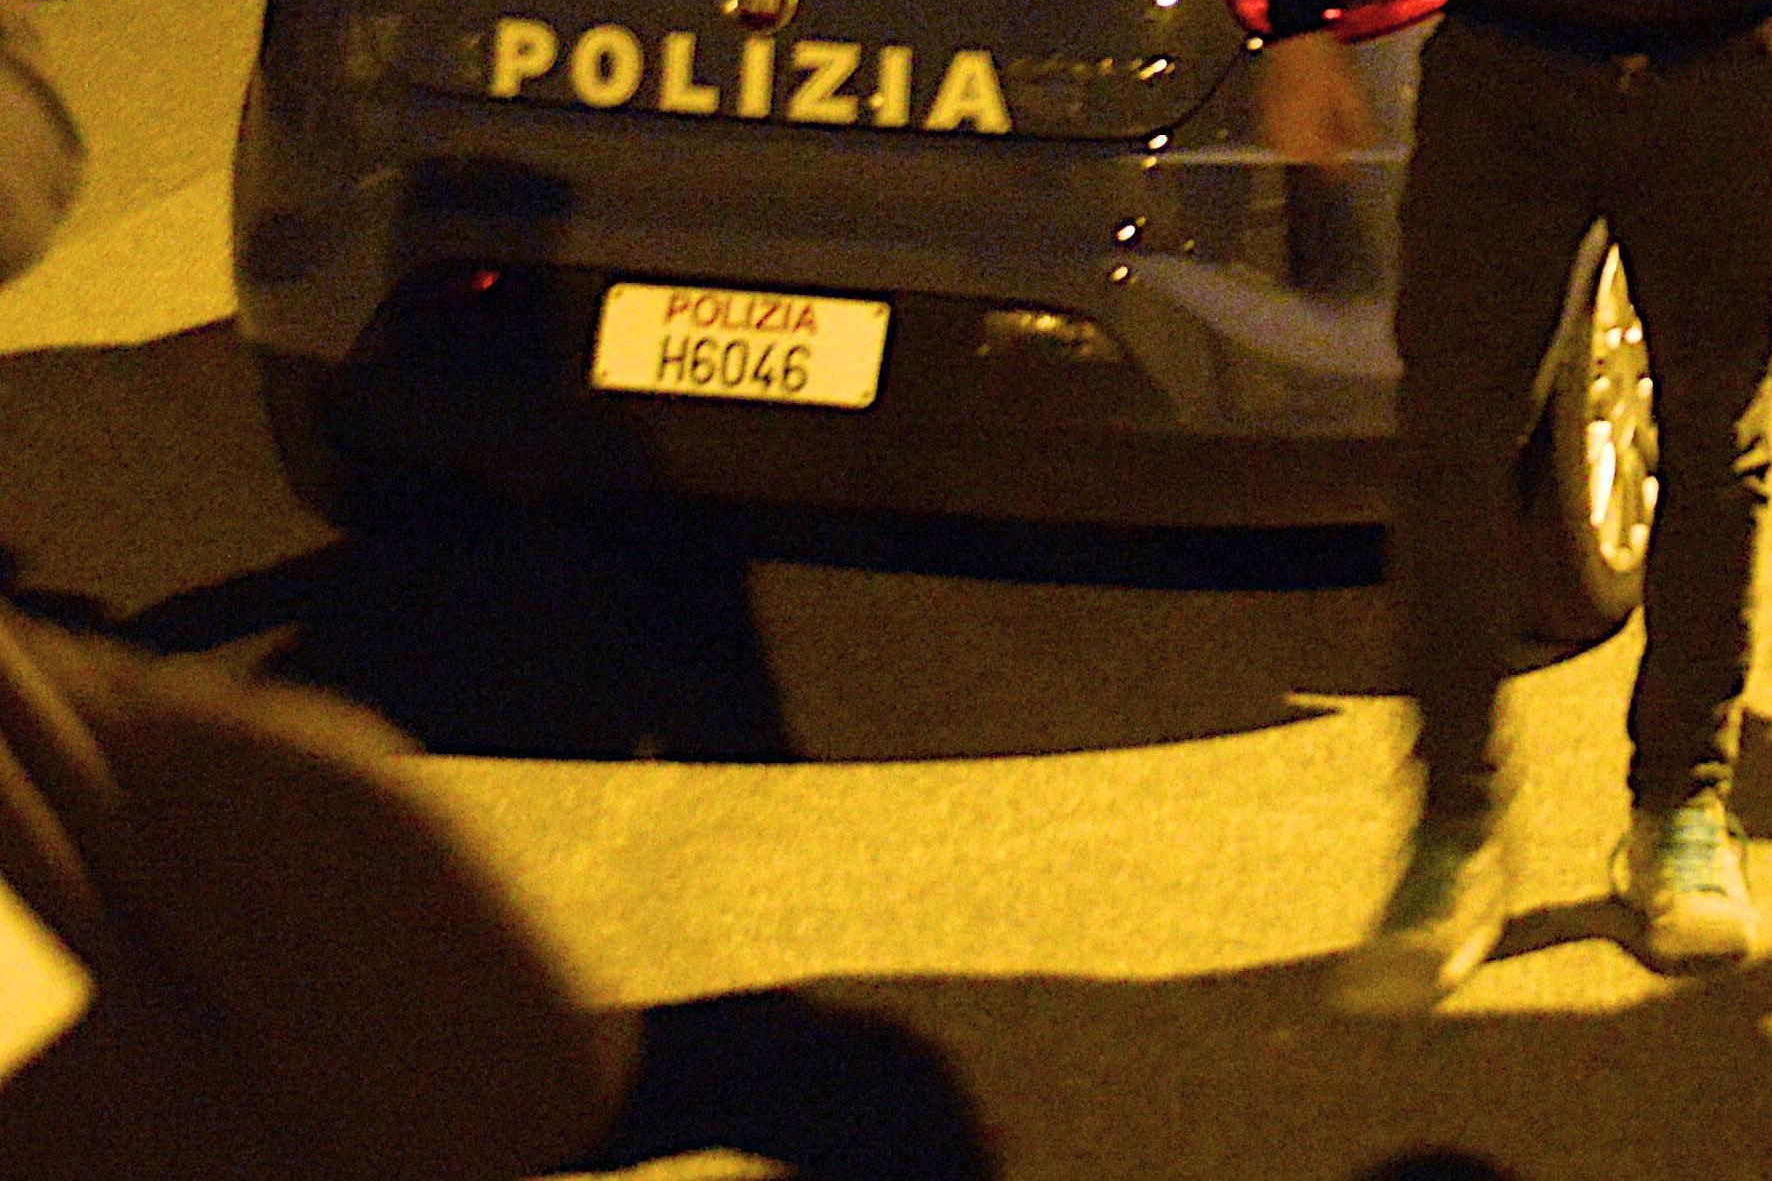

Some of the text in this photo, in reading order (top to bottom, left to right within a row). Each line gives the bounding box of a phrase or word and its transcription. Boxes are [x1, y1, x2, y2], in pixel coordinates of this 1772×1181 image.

[490, 18, 1013, 134] POLIZIA
[665, 289, 817, 334] POLIZIA
[656, 335, 811, 392] H6046
